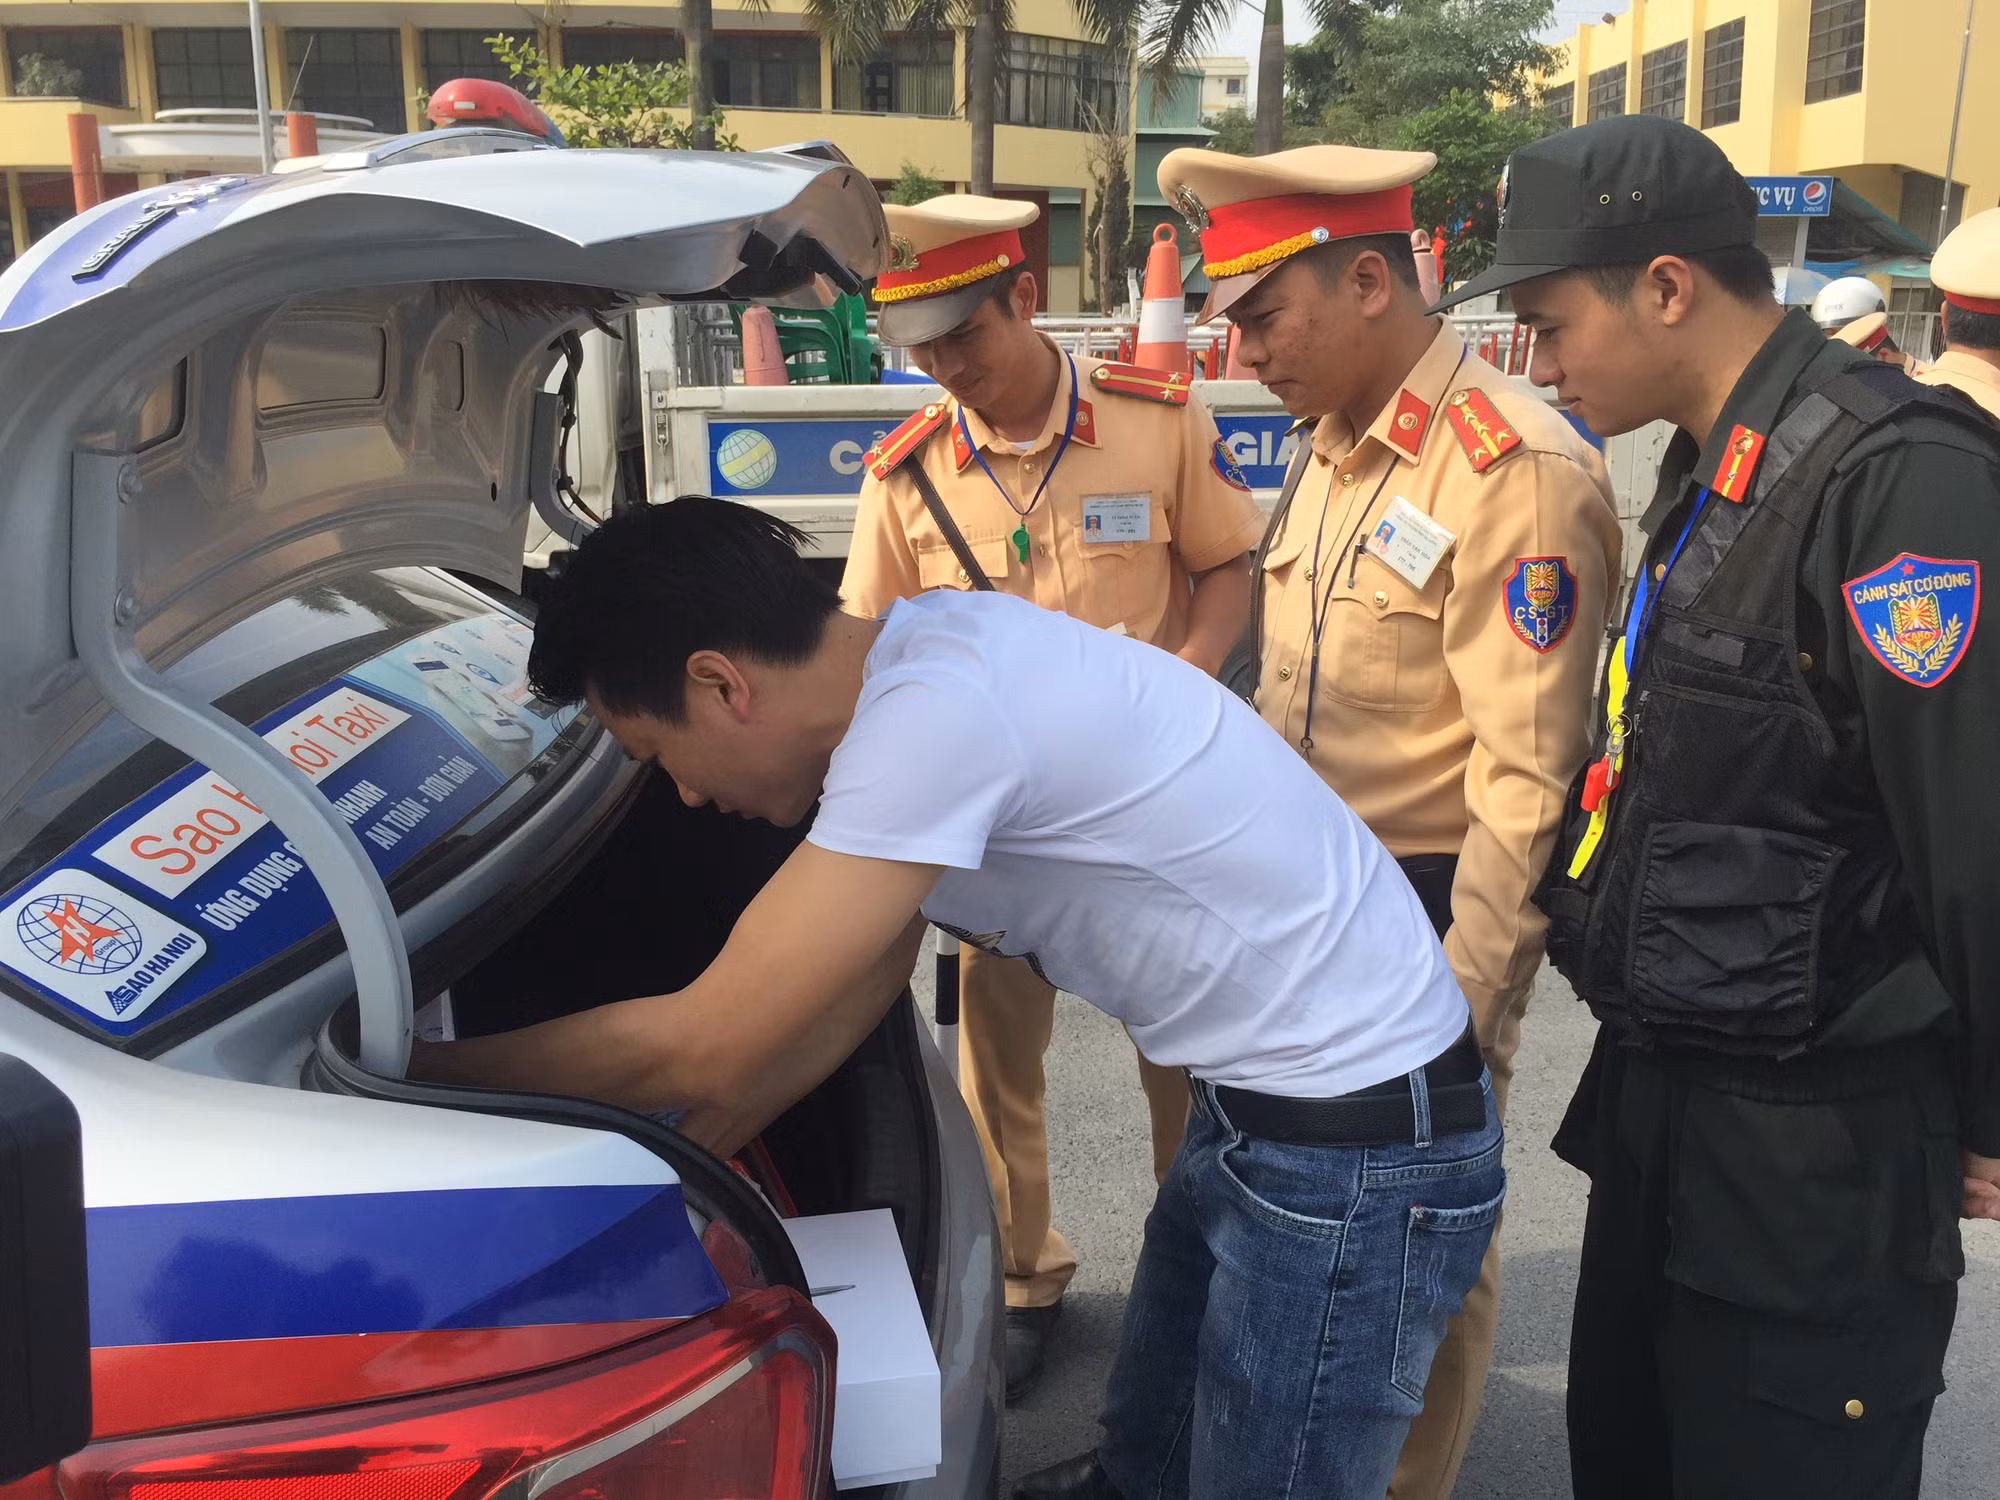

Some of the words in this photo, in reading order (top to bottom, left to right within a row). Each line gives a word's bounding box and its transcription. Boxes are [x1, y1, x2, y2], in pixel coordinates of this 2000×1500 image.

[1773, 186, 1796, 211] VỤ
[1802, 205, 1824, 213] pepsi
[1854, 585, 1889, 604] CẢNH
[1889, 579, 1913, 597] SÁT
[1914, 575, 1934, 593] CƠ
[1933, 571, 1971, 592] ĐỘNG
[130, 808, 241, 875] Sao
[304, 696, 390, 746] Taxi
[417, 773, 458, 803] ĐƠN
[381, 796, 431, 833] TOÀN
[364, 822, 403, 851] AN
[195, 888, 261, 931] ỨNG
[237, 851, 304, 900] DỤNG
[332, 779, 388, 825] NHANH
[95, 939, 117, 956] Group
